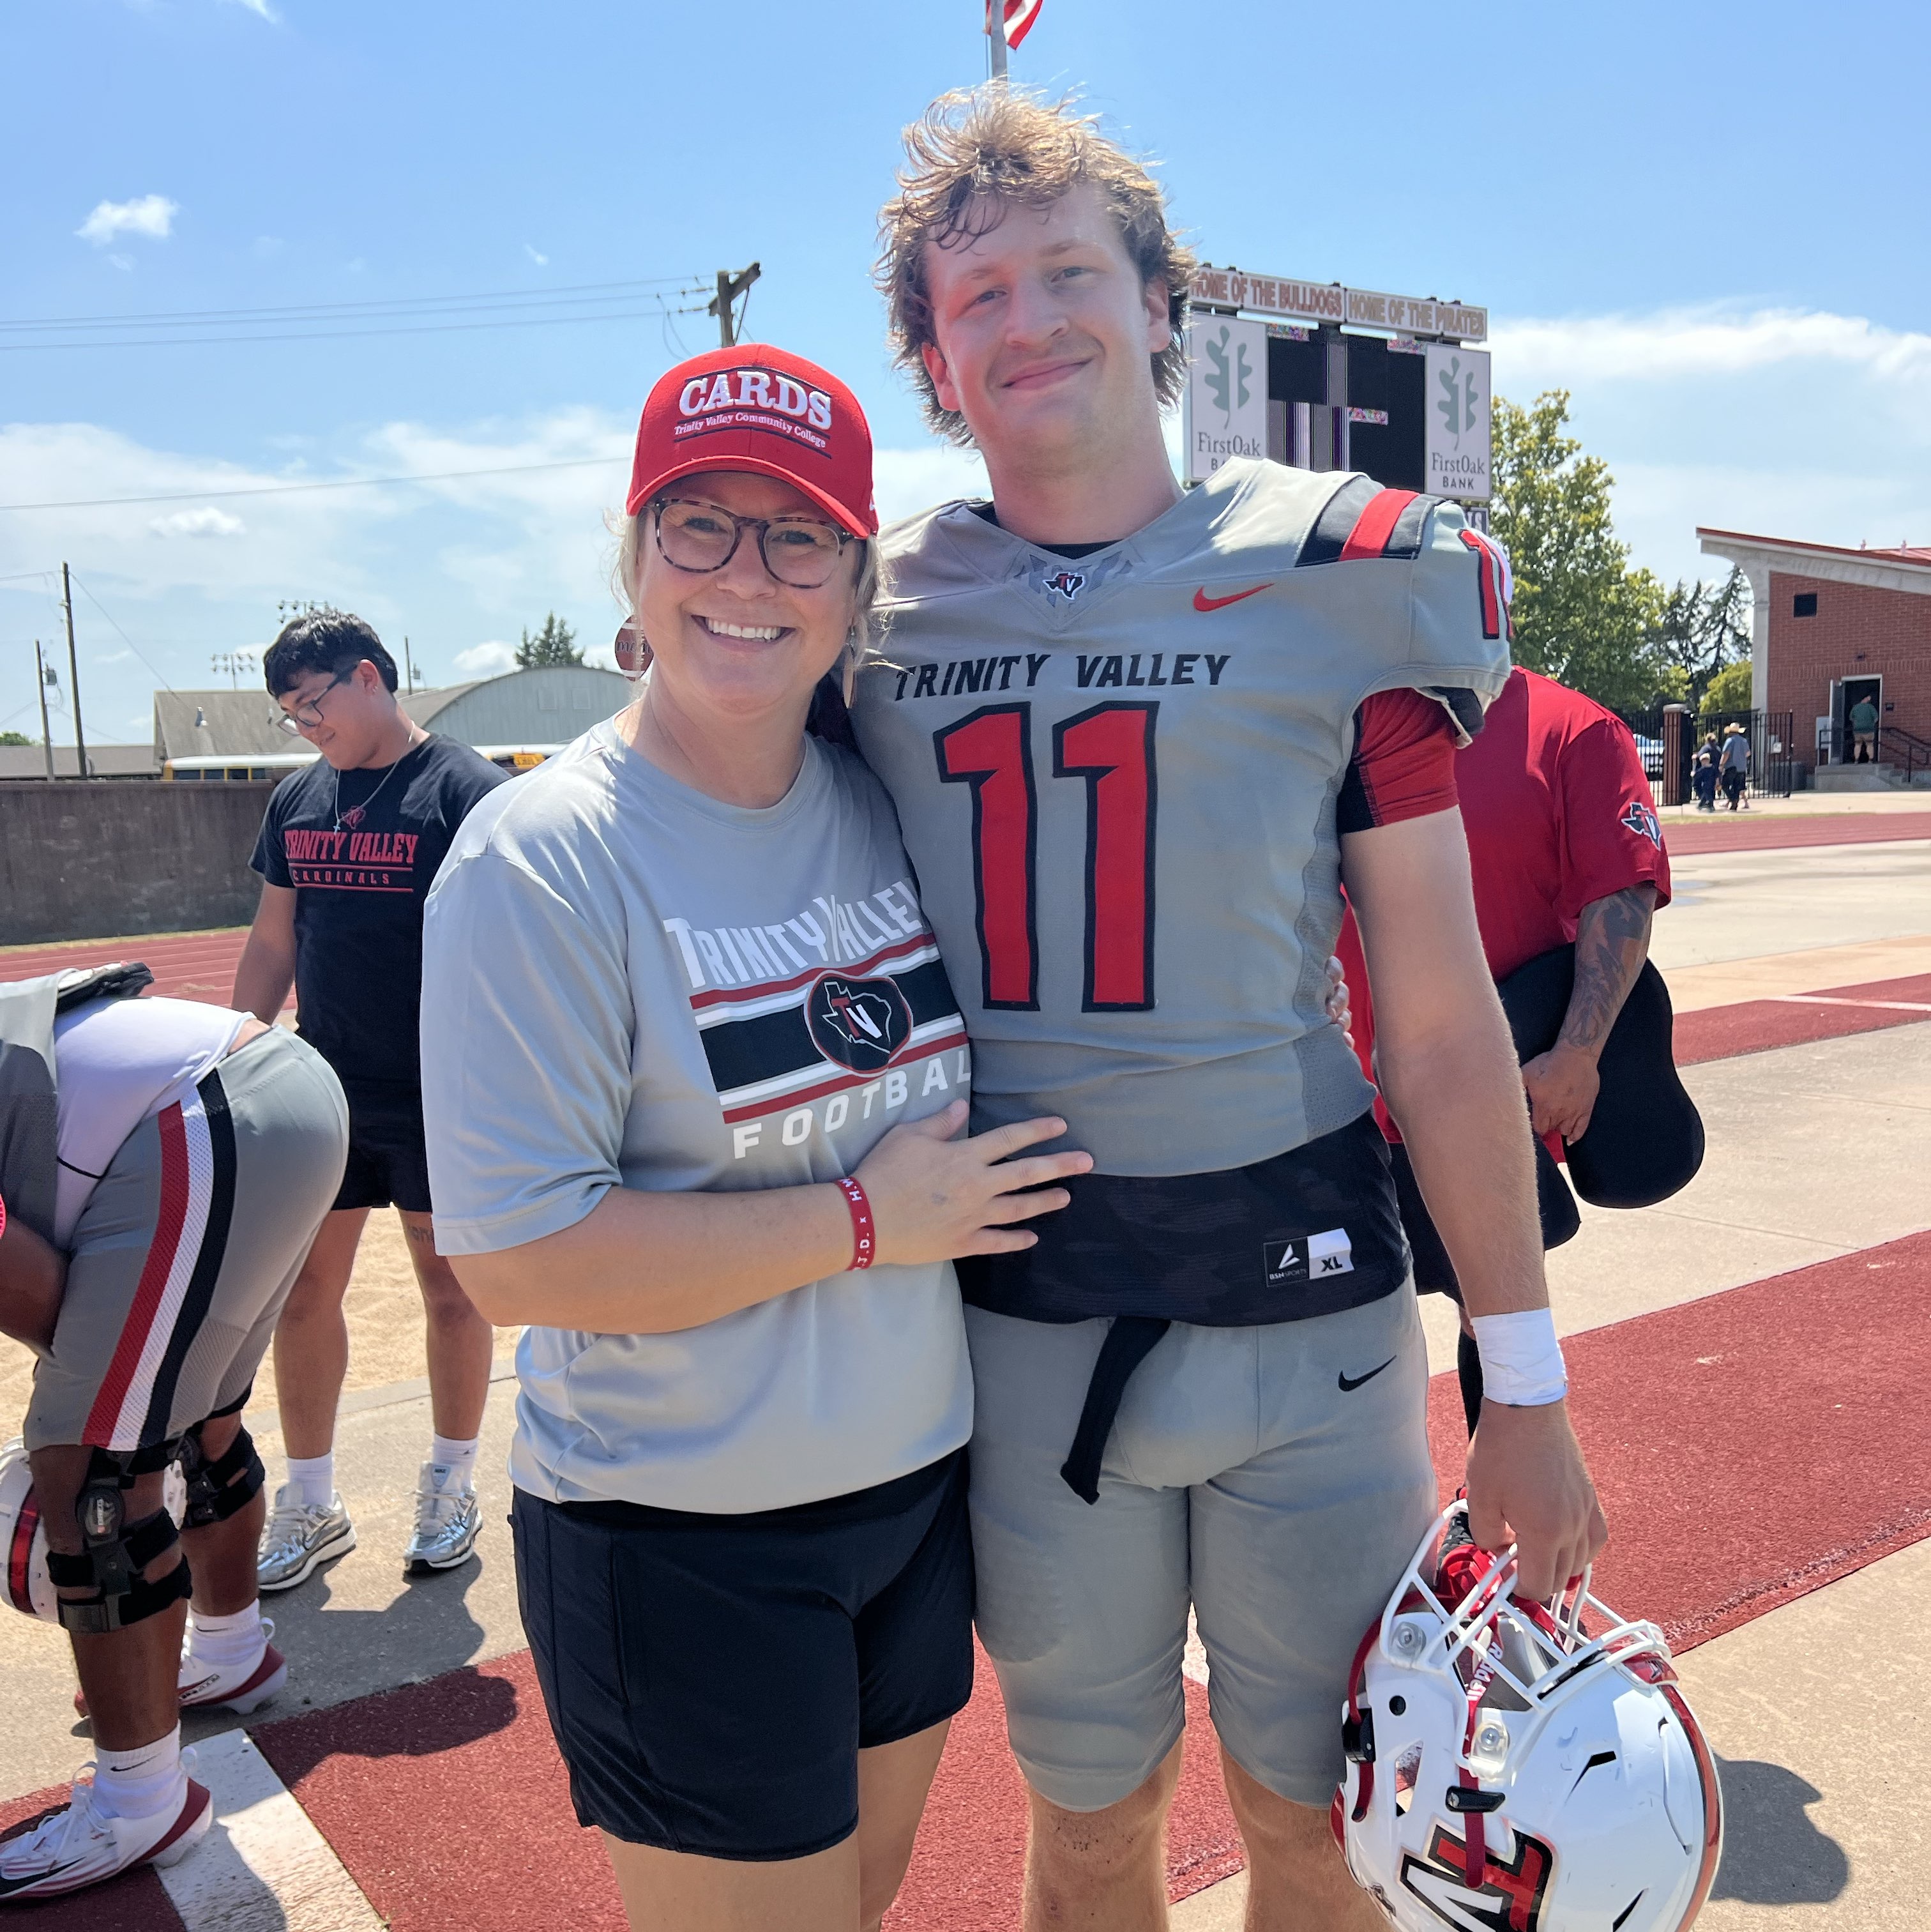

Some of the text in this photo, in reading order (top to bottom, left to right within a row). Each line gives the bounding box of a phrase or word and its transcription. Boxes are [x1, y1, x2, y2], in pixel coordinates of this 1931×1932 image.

[1231, 275, 1248, 303] OF
[1251, 278, 1276, 307] THE
[1279, 282, 1342, 316] BULLDOGS
[1348, 293, 1484, 335] HOME OF THE PIRATES
[679, 371, 832, 430] CARDS
[674, 412, 826, 448] Trinity Valley Community College
[1197, 431, 1261, 456] FirstOak
[1432, 452, 1485, 475] FirstOak
[1443, 476, 1474, 491] BANK
[895, 653, 1231, 701] TRINITY VALLEY
[349, 832, 419, 864] VALLEY
[933, 701, 1161, 1013] 11
[292, 870, 390, 885] CARDINALS
[663, 911, 829, 989] TRINITY
[1321, 1256, 1343, 1273] XL
